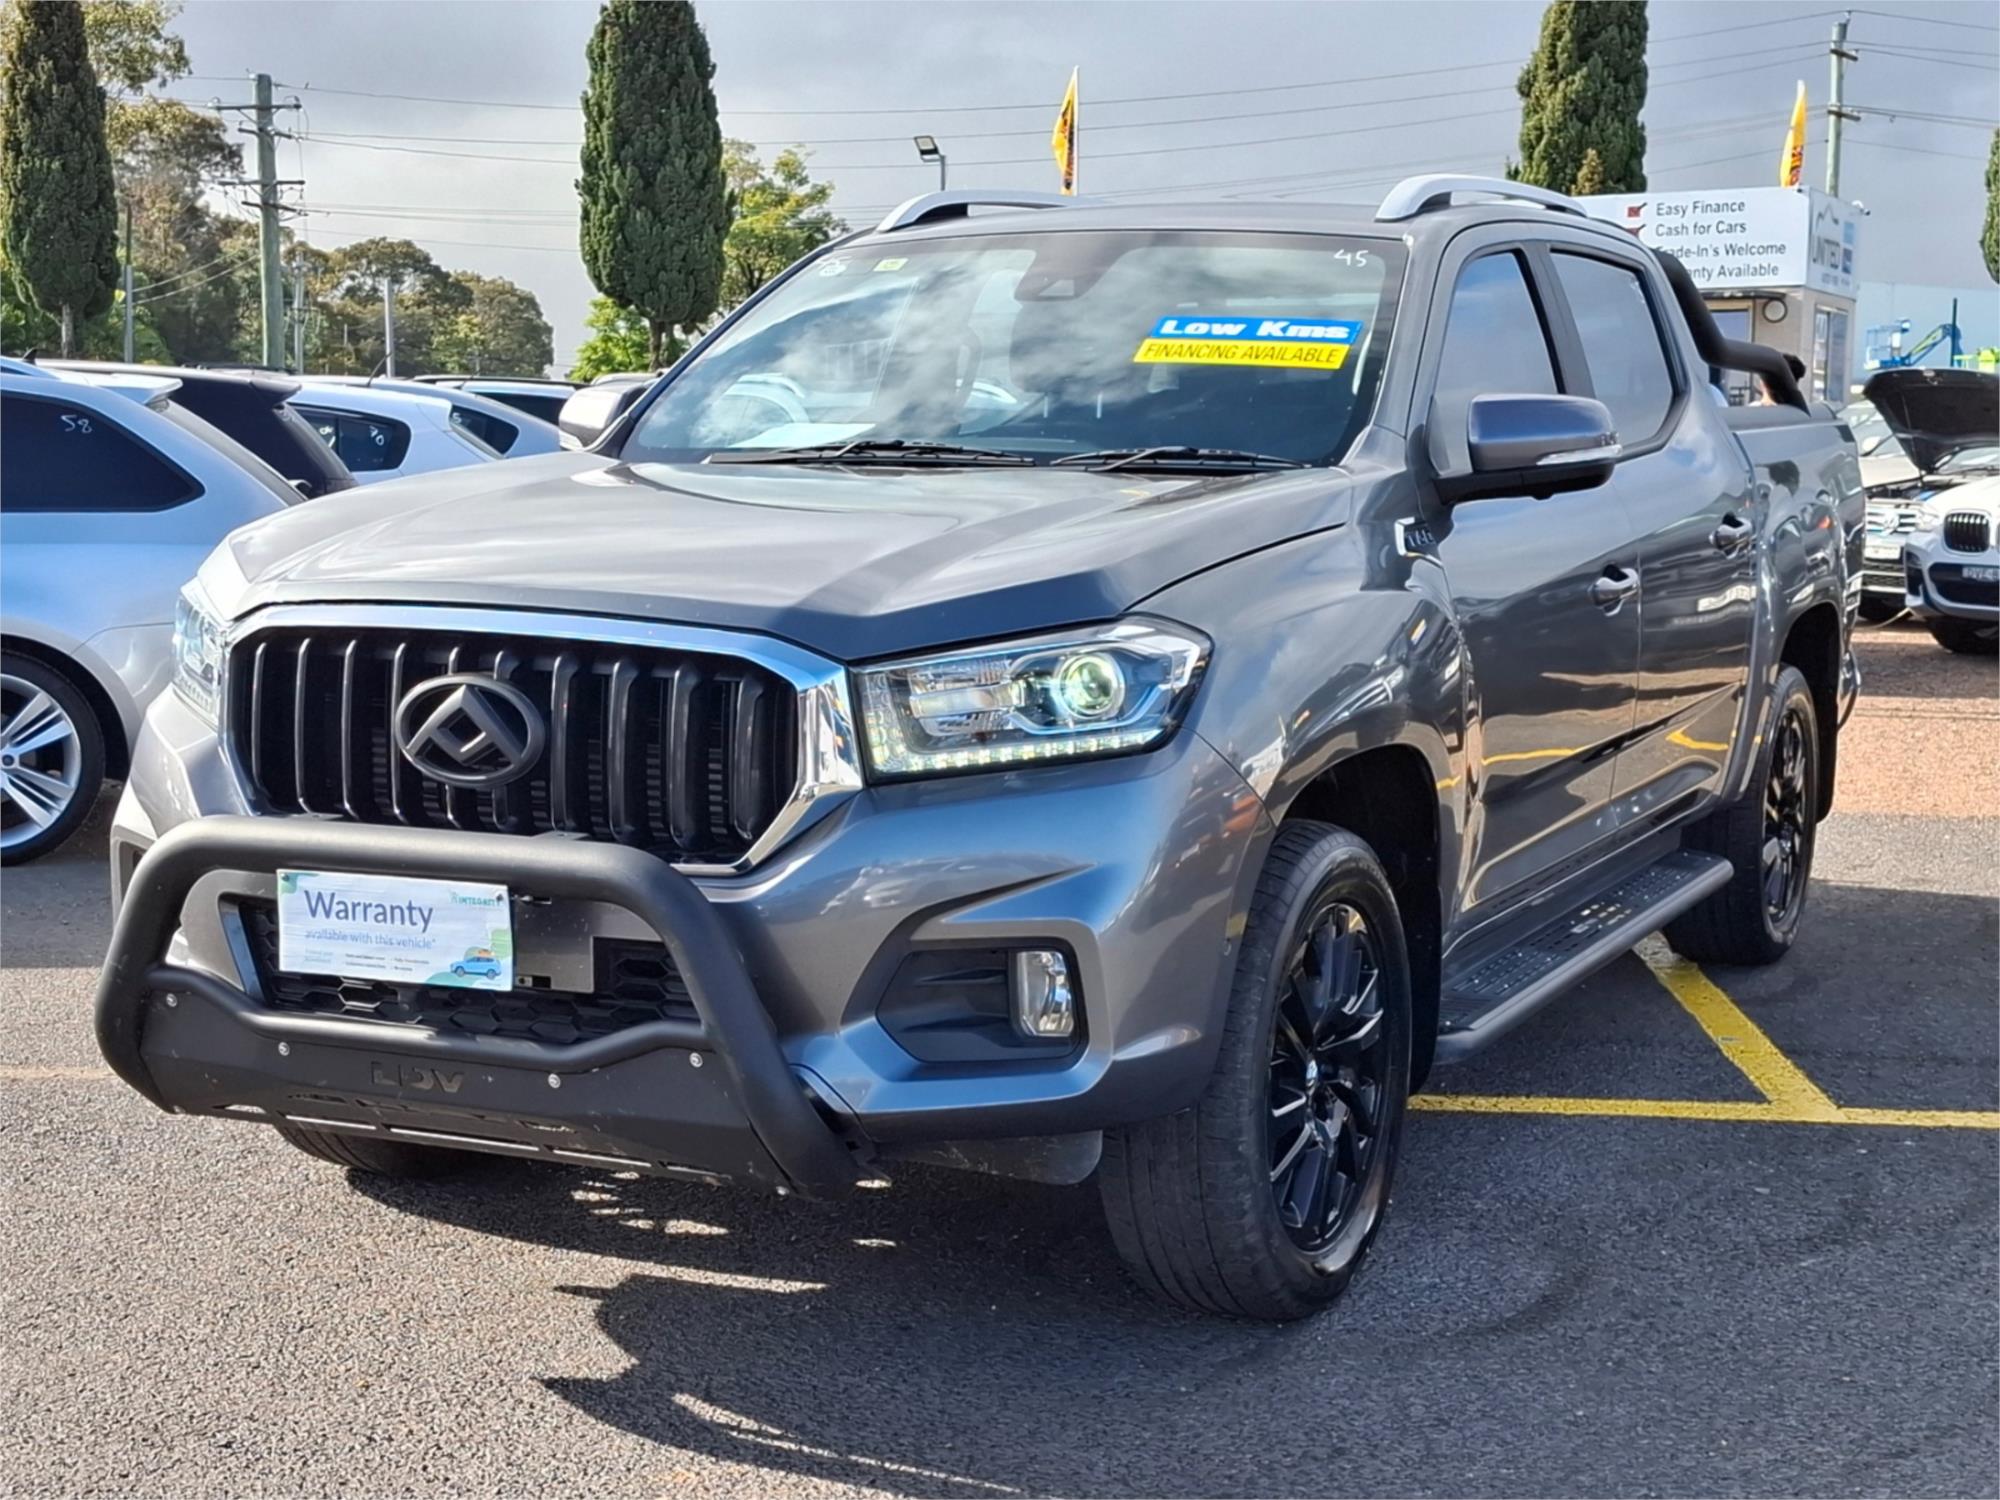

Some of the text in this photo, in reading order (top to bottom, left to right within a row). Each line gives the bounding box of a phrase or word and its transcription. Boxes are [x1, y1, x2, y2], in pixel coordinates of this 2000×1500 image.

[1656, 200, 1746, 218] Easy Finance
[1655, 220, 1747, 237] Cash for Cars
[1333, 248, 1369, 267] 45
[1656, 243, 1787, 259] ade-In's Welcome
[1717, 263, 1779, 277] Available
[1159, 319, 1351, 339] Low Kms
[1143, 343, 1340, 363] FINANCING AVAILABLE
[60, 414, 93, 434] 58
[304, 890, 433, 934] Warranty
[305, 928, 348, 942] available
[350, 931, 373, 945] with
[375, 933, 394, 946] this
